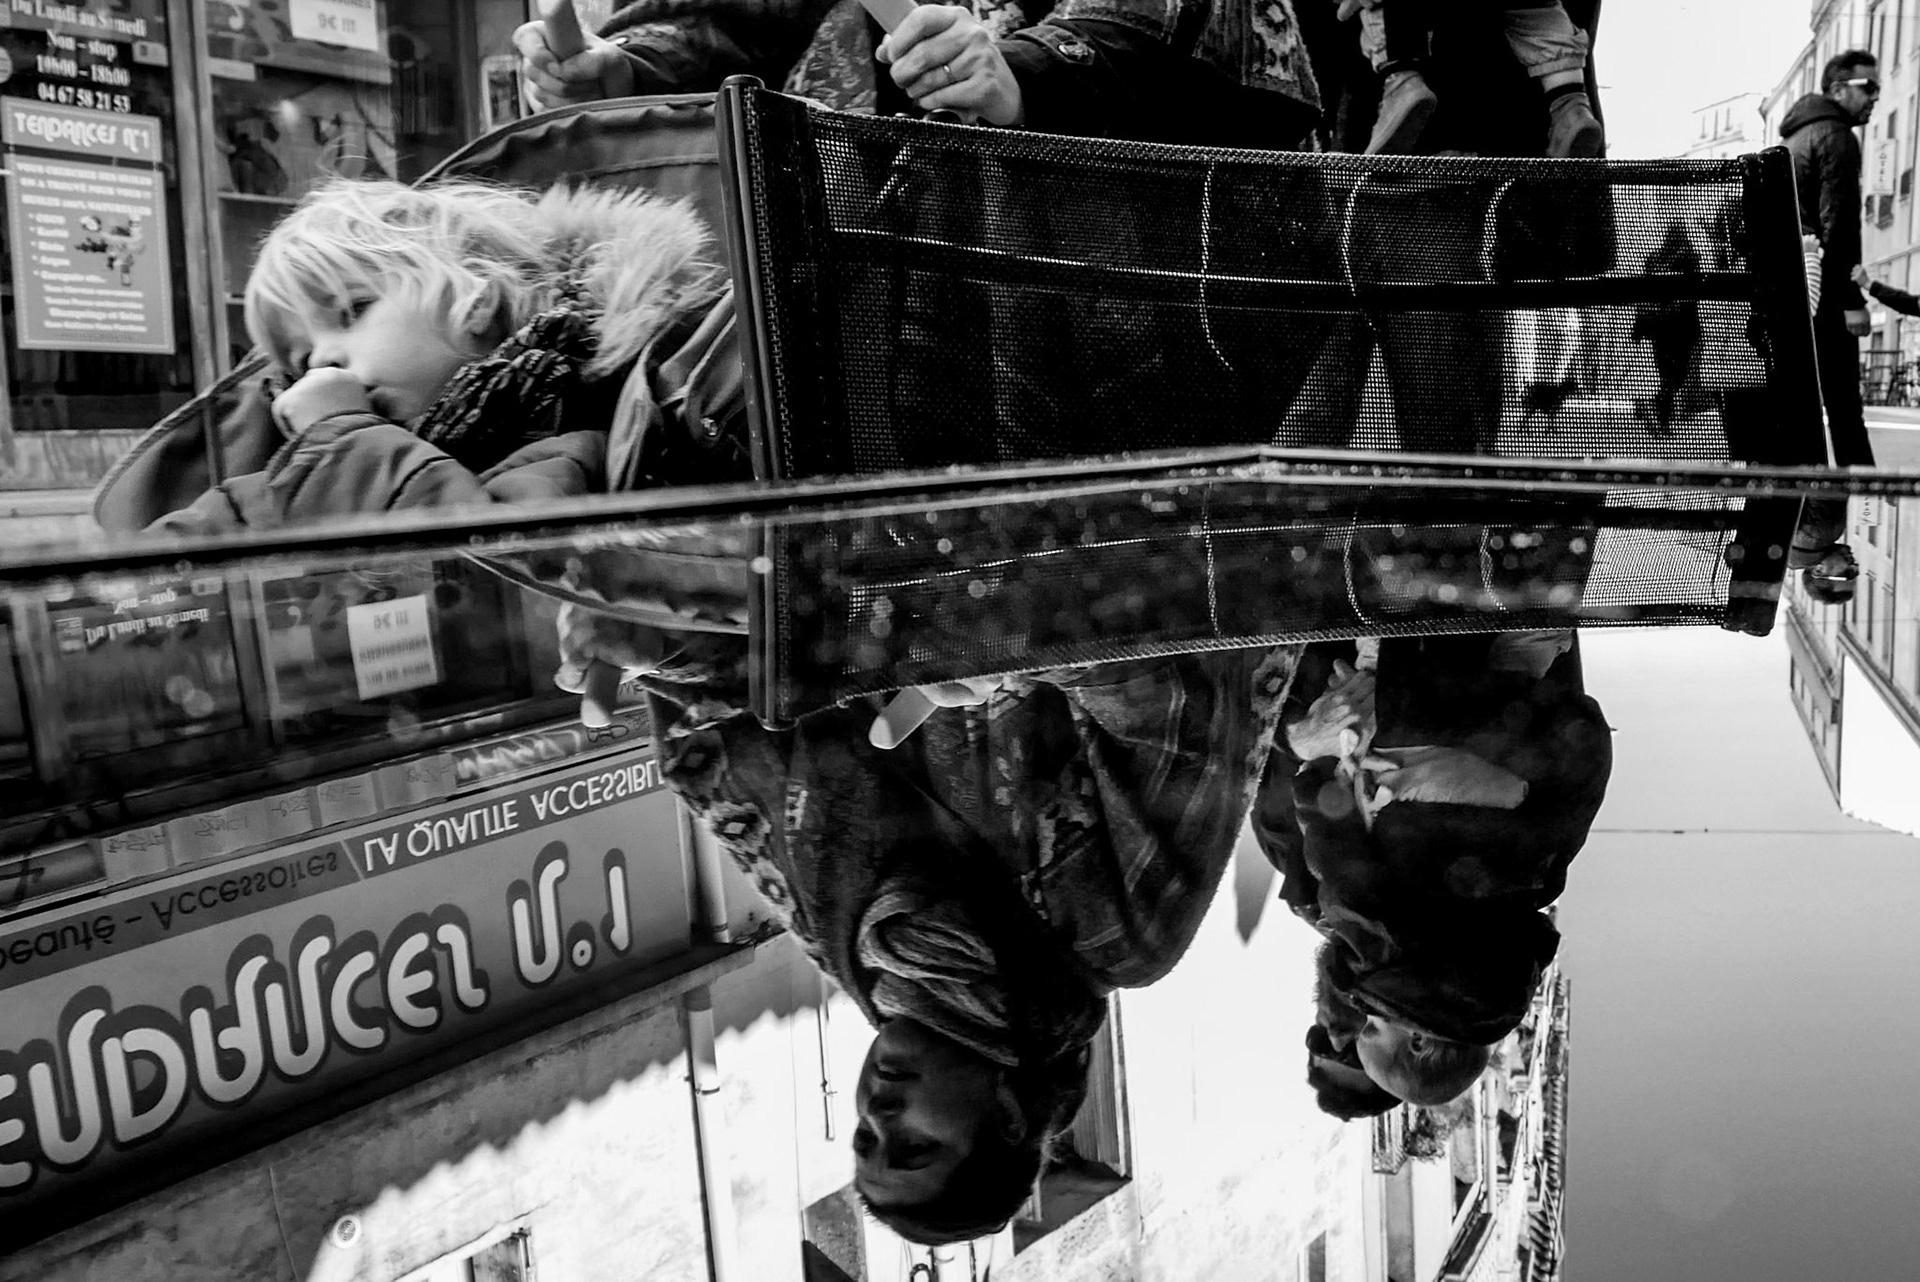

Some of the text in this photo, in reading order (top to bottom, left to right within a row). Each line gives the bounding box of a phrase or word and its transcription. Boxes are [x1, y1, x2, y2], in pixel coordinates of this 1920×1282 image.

[35, 0, 77, 24] Lundi
[79, 11, 97, 27] au
[88, 40, 118, 62] stop
[37, 82, 56, 101] 04
[57, 85, 75, 104] 67
[95, 91, 111, 111] 21
[113, 94, 132, 113] 53
[13, 112, 118, 147] TENDANCES
